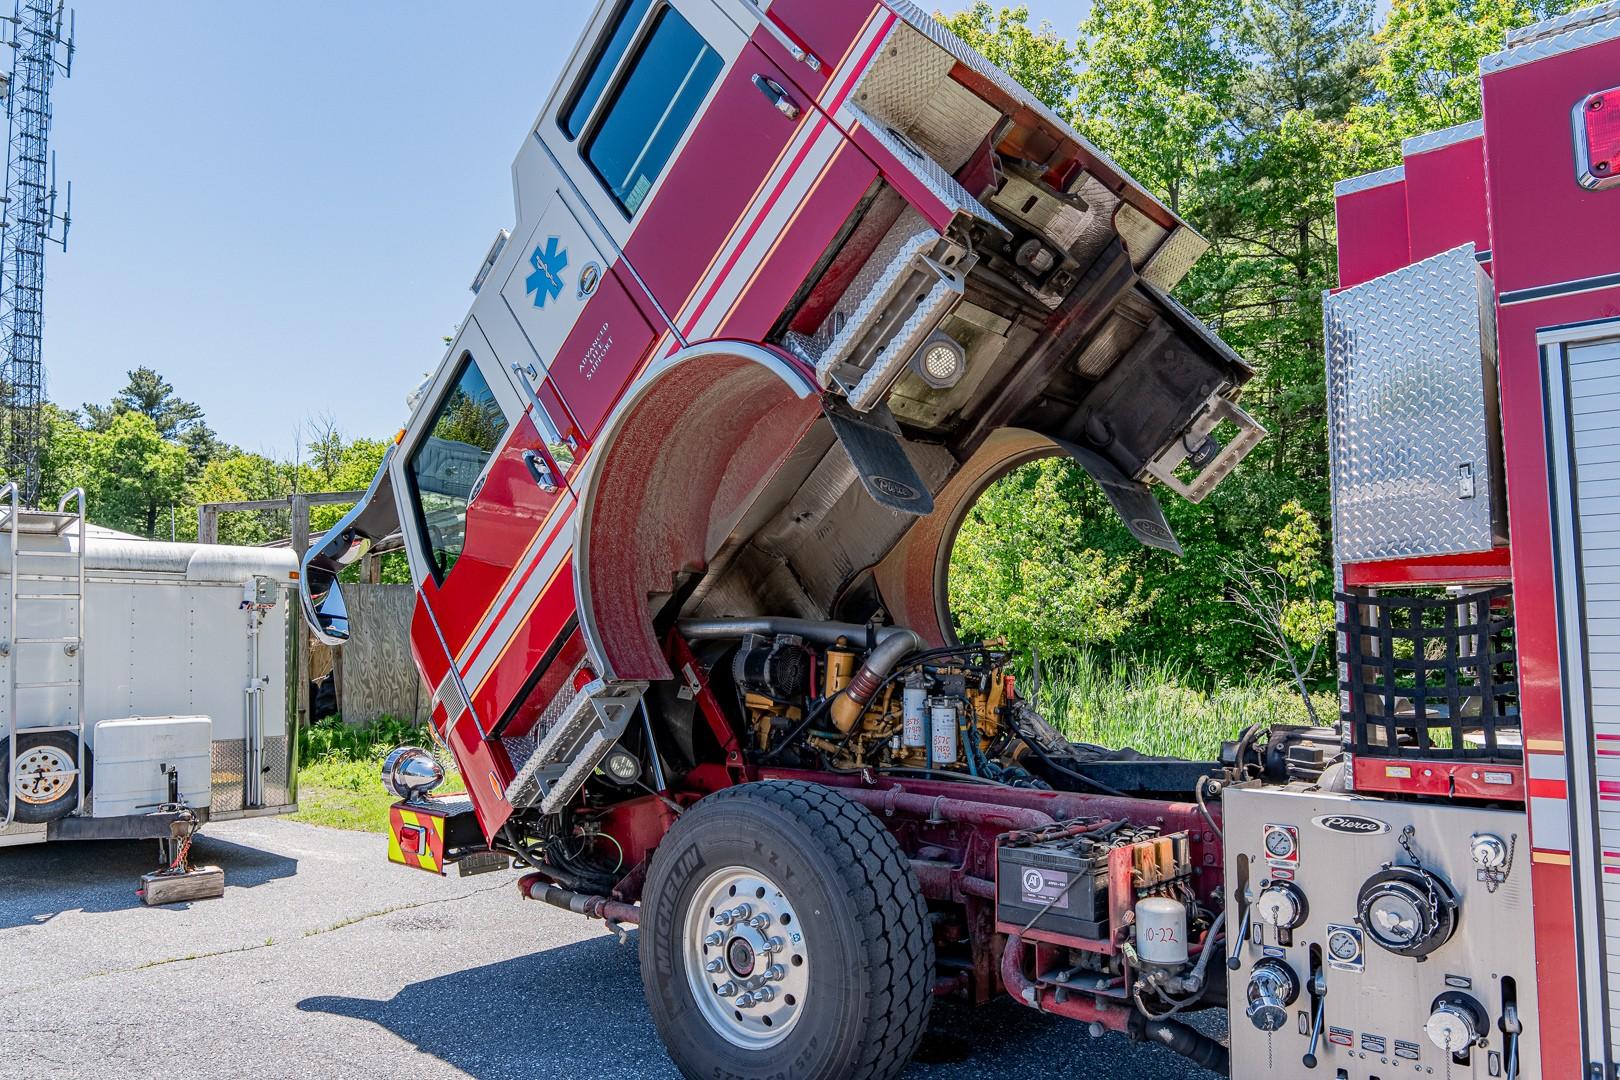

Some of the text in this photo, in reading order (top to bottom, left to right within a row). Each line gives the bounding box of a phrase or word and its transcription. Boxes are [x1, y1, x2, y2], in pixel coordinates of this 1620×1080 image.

[579, 322, 609, 374] ADVANCED
[586, 336, 613, 380] SUPPORT
[1324, 817, 1377, 831] Pierce
[656, 845, 701, 975] MICHELIN
[1145, 927, 1179, 943] 10-22
